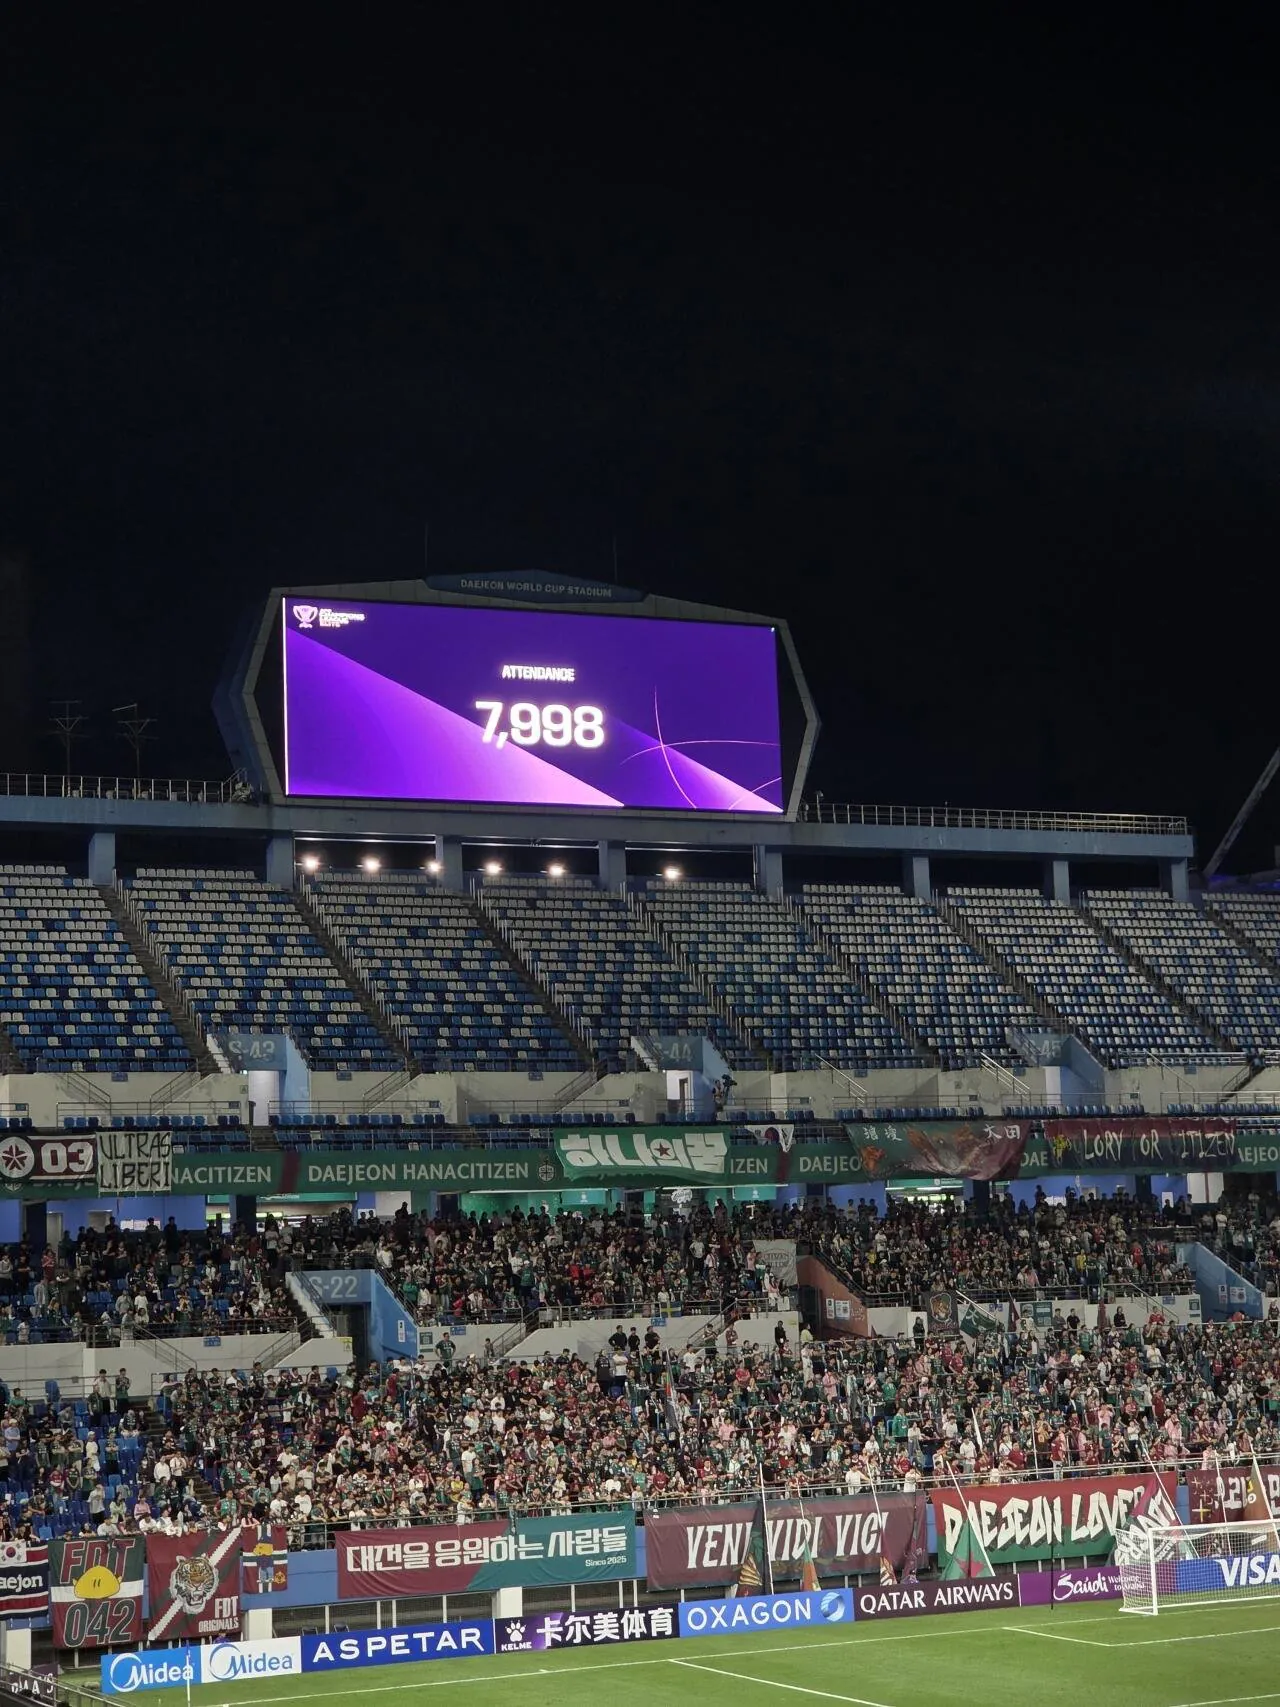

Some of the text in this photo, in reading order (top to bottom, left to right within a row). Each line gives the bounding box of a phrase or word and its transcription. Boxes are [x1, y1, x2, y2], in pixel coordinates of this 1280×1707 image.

[461, 579, 612, 597] DAEJEON WORLD CUP STADIUM
[502, 665, 575, 681] ATTENDANCE
[475, 701, 605, 749] 7,998
[41, 1142, 94, 1173] 03
[100, 1132, 171, 1160] ULTRAS
[1074, 1128, 1124, 1162] LORY
[1171, 1128, 1236, 1160] ITIZEN
[100, 1161, 170, 1189] LIBERI
[308, 1162, 529, 1185] DAEJEON HANACITIZEN
[309, 1276, 358, 1299] S-22
[346, 1525, 627, 1572] 대전을 응원하는 사람들
[767, 1516, 823, 1562] VIDI
[836, 1511, 889, 1557] VICI
[60, 1538, 136, 1585] FDT
[585, 1559, 606, 1567] Since
[214, 1596, 239, 1619] FDT
[860, 1582, 1014, 1614] QATAR AIRWAYS
[63, 1598, 136, 1648] 042
[198, 1617, 239, 1633] ORIGINALS
[536, 1607, 674, 1648] 卡尔美体育
[687, 1597, 812, 1631] OXAGON
[312, 1627, 485, 1663] ASPETAR
[501, 1641, 532, 1652] KELME
[122, 1661, 195, 1688] Midea
[222, 1652, 293, 1680] Midea
